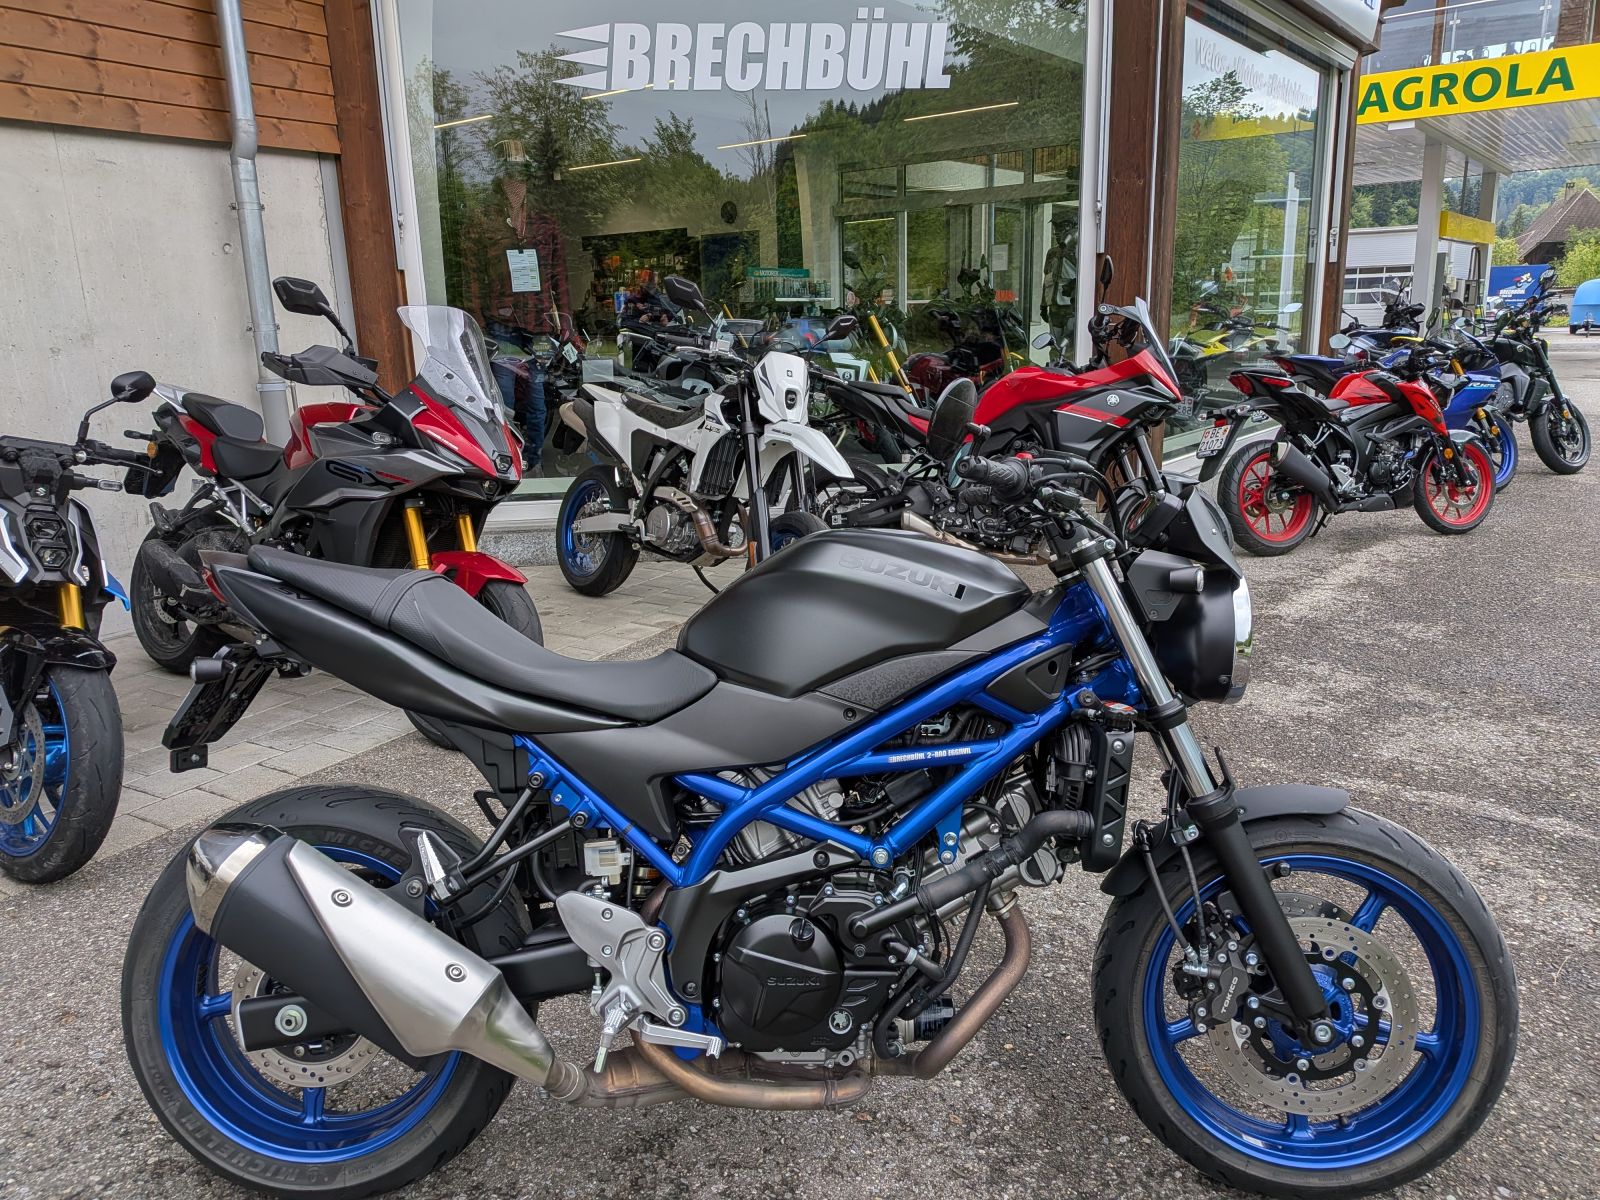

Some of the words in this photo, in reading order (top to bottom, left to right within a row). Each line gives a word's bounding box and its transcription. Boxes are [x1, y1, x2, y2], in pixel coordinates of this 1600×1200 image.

[611, 8, 951, 91] BRECHBÜHL
[1358, 57, 1575, 116] AGROLA
[1199, 438, 1224, 451] 21073
[1210, 428, 1222, 438] BE
[838, 552, 967, 600] SUZUKI
[324, 830, 407, 867] MICHE
[767, 976, 820, 986] SUZUKI
[1220, 976, 1239, 1014] TOKICO
[181, 1111, 300, 1183] MICHELIN
